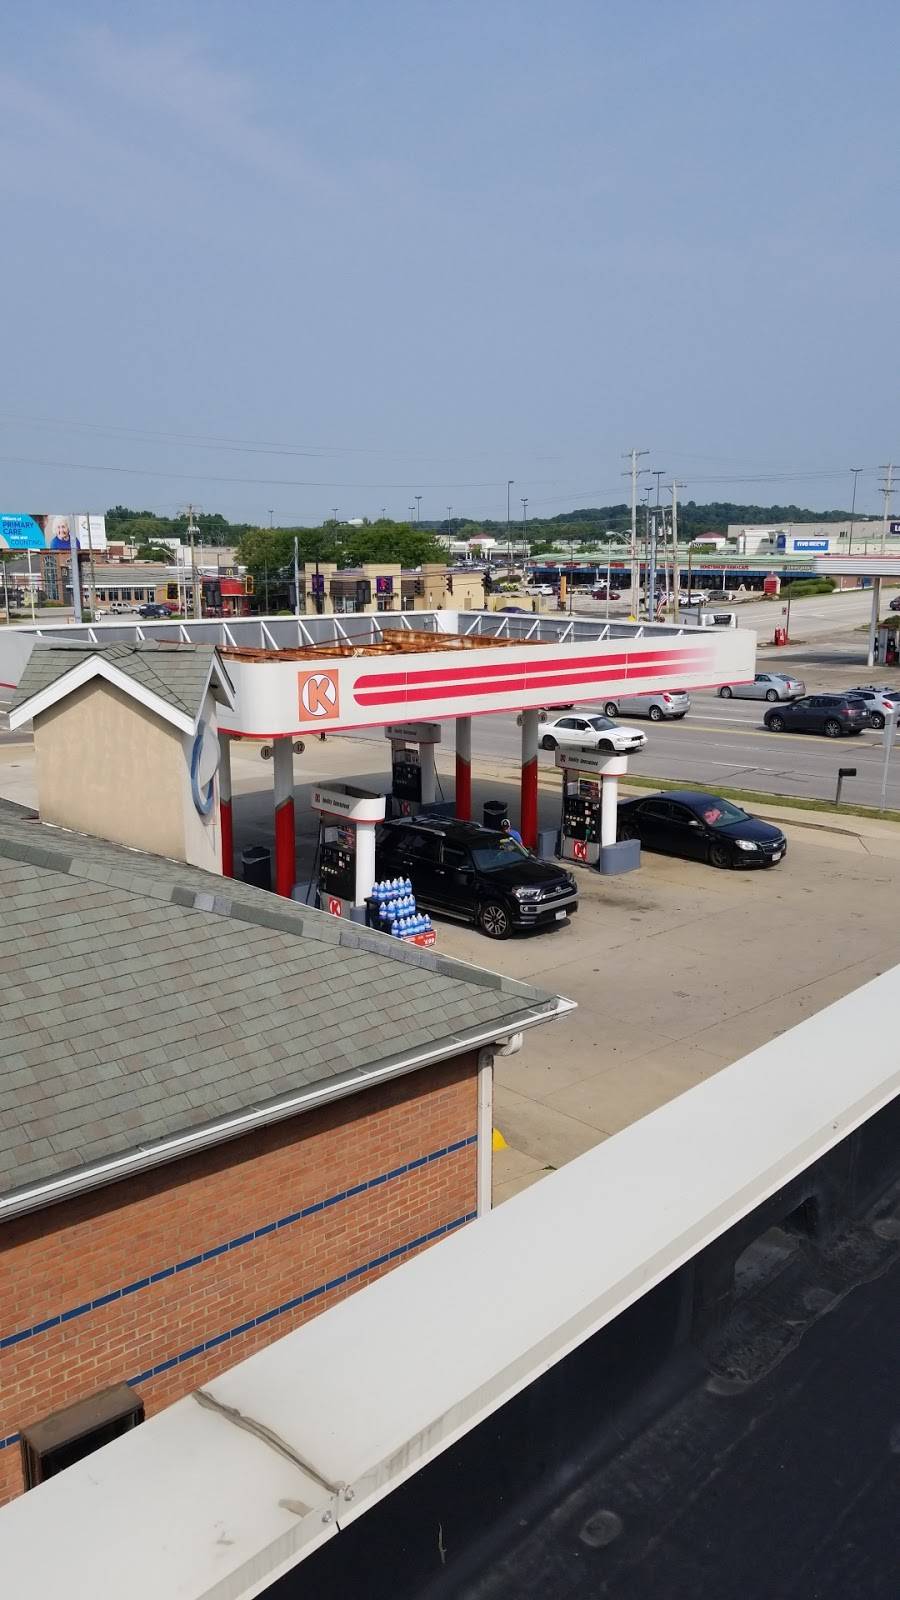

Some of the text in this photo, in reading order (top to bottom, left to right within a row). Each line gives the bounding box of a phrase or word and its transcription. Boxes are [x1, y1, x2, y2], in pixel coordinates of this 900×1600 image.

[2, 520, 34, 528] PRIMARY
[3, 528, 22, 536] CARE
[308, 677, 335, 713] K
